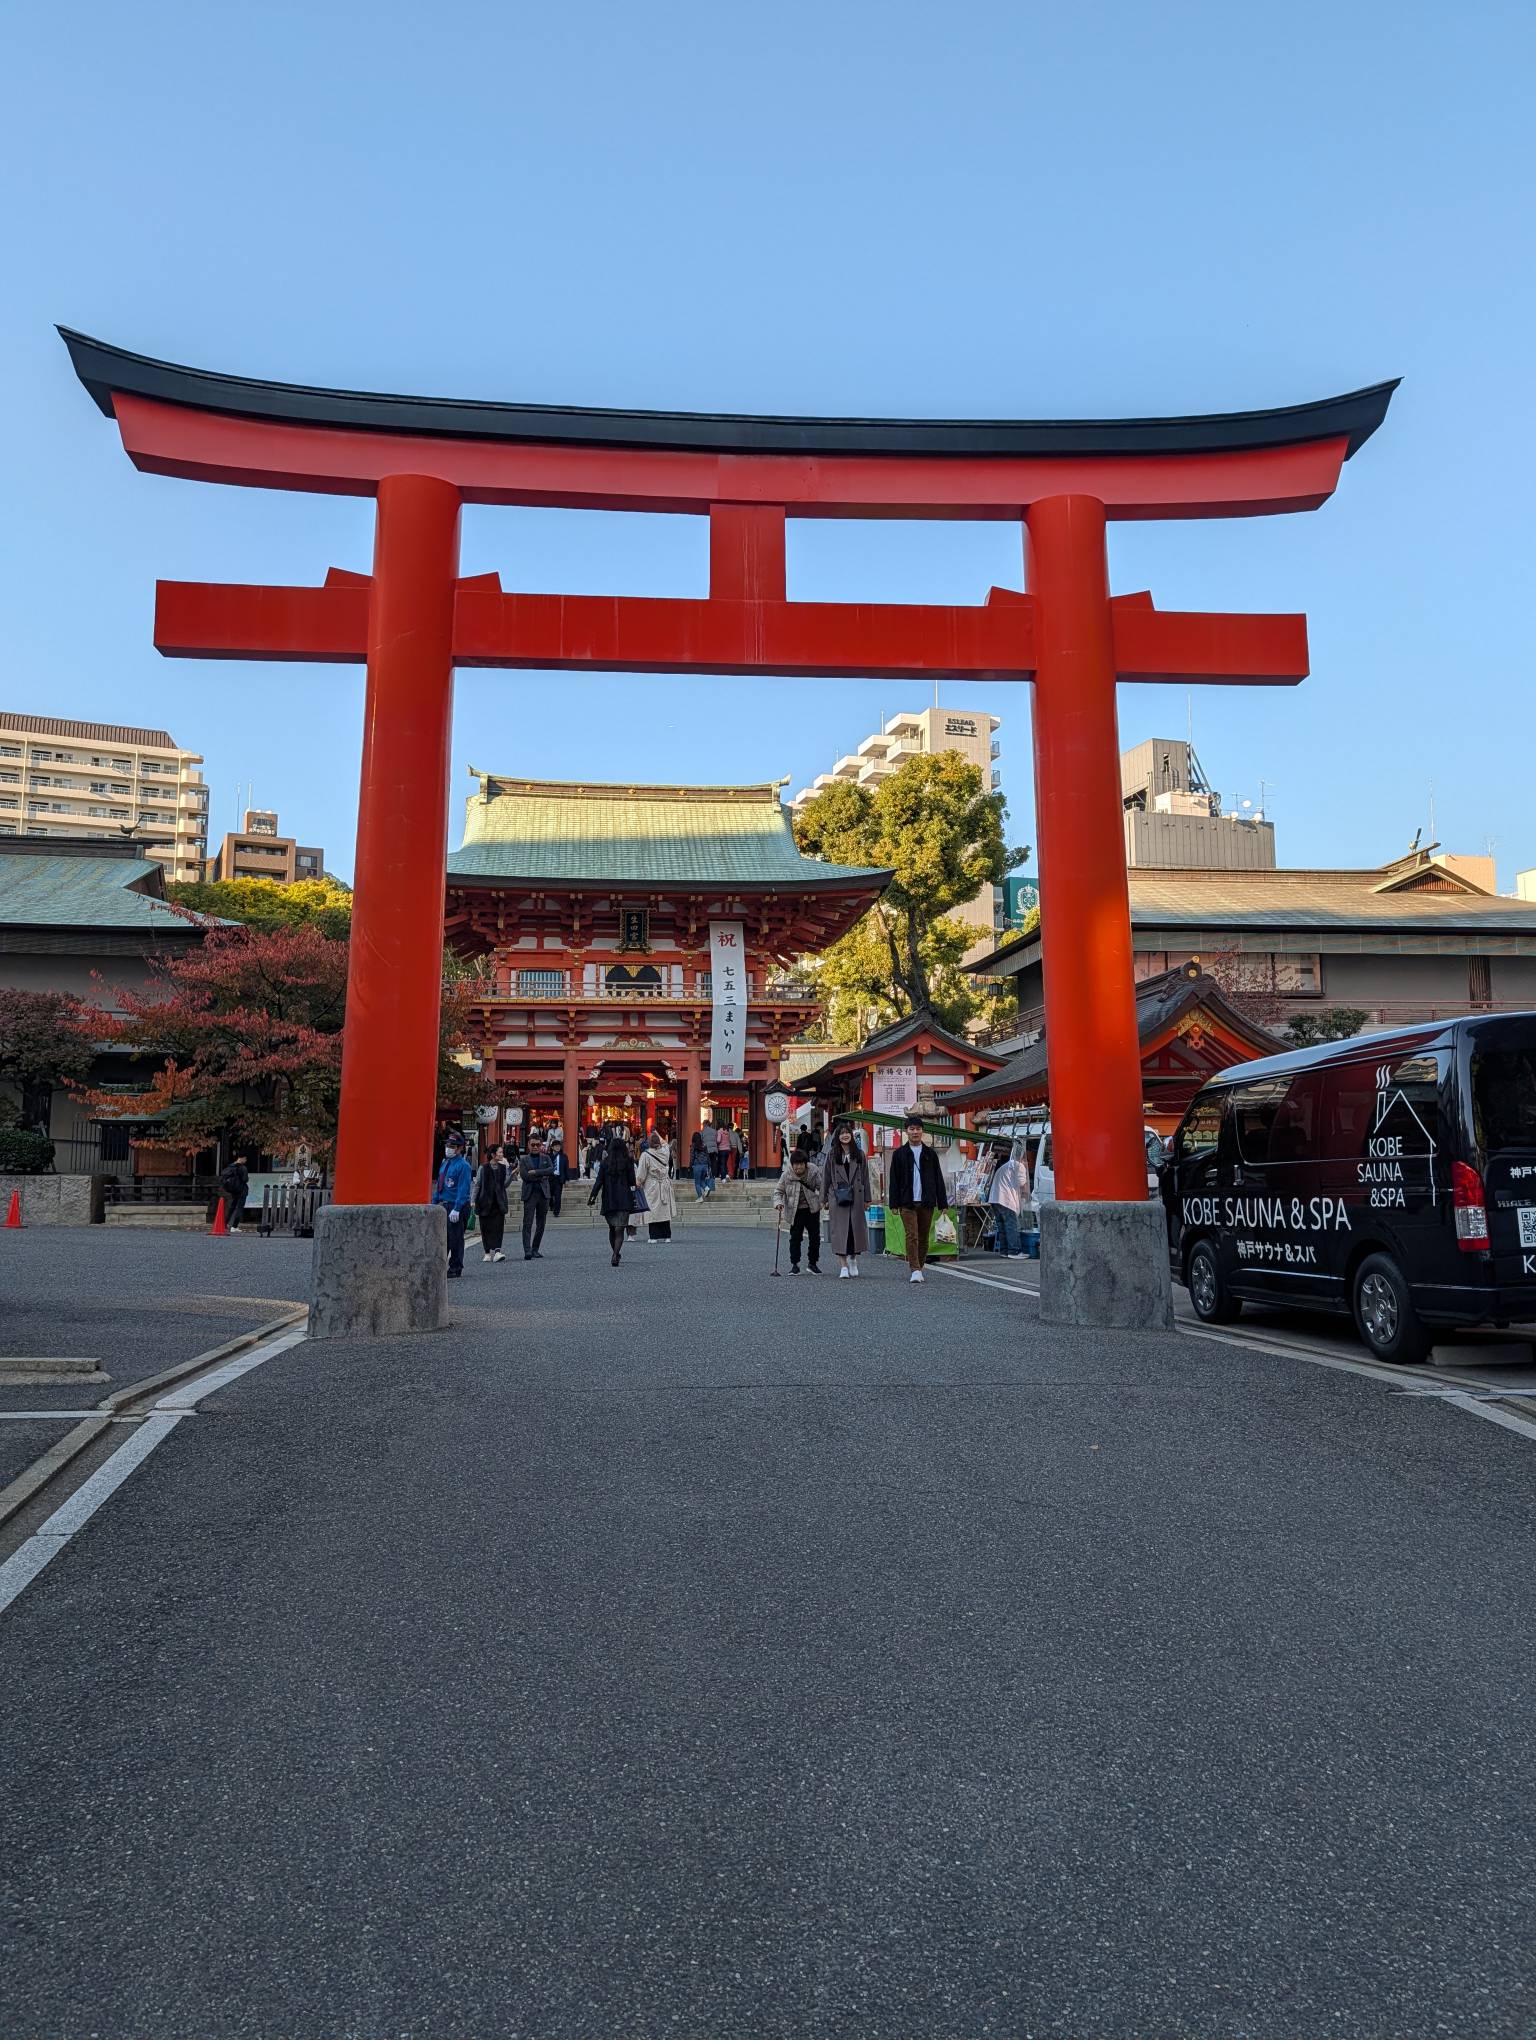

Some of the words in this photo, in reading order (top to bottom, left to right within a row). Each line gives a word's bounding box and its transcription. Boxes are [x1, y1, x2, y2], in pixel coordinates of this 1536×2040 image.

[945, 724, 977, 734] エスリード
[717, 931, 737, 948] 祝
[722, 966, 737, 1054] 七五三まいり
[1369, 1136, 1403, 1157] KOBE
[1357, 1162, 1403, 1183] SAUNA
[1370, 1187, 1406, 1208] &SPA
[1182, 1197, 1221, 1226] KOBE
[1225, 1197, 1287, 1229] SAUNA
[1290, 1197, 1306, 1230] &
[1309, 1197, 1352, 1231] SPA
[1236, 1239, 1317, 1264] 神戸サウナ&スパ
